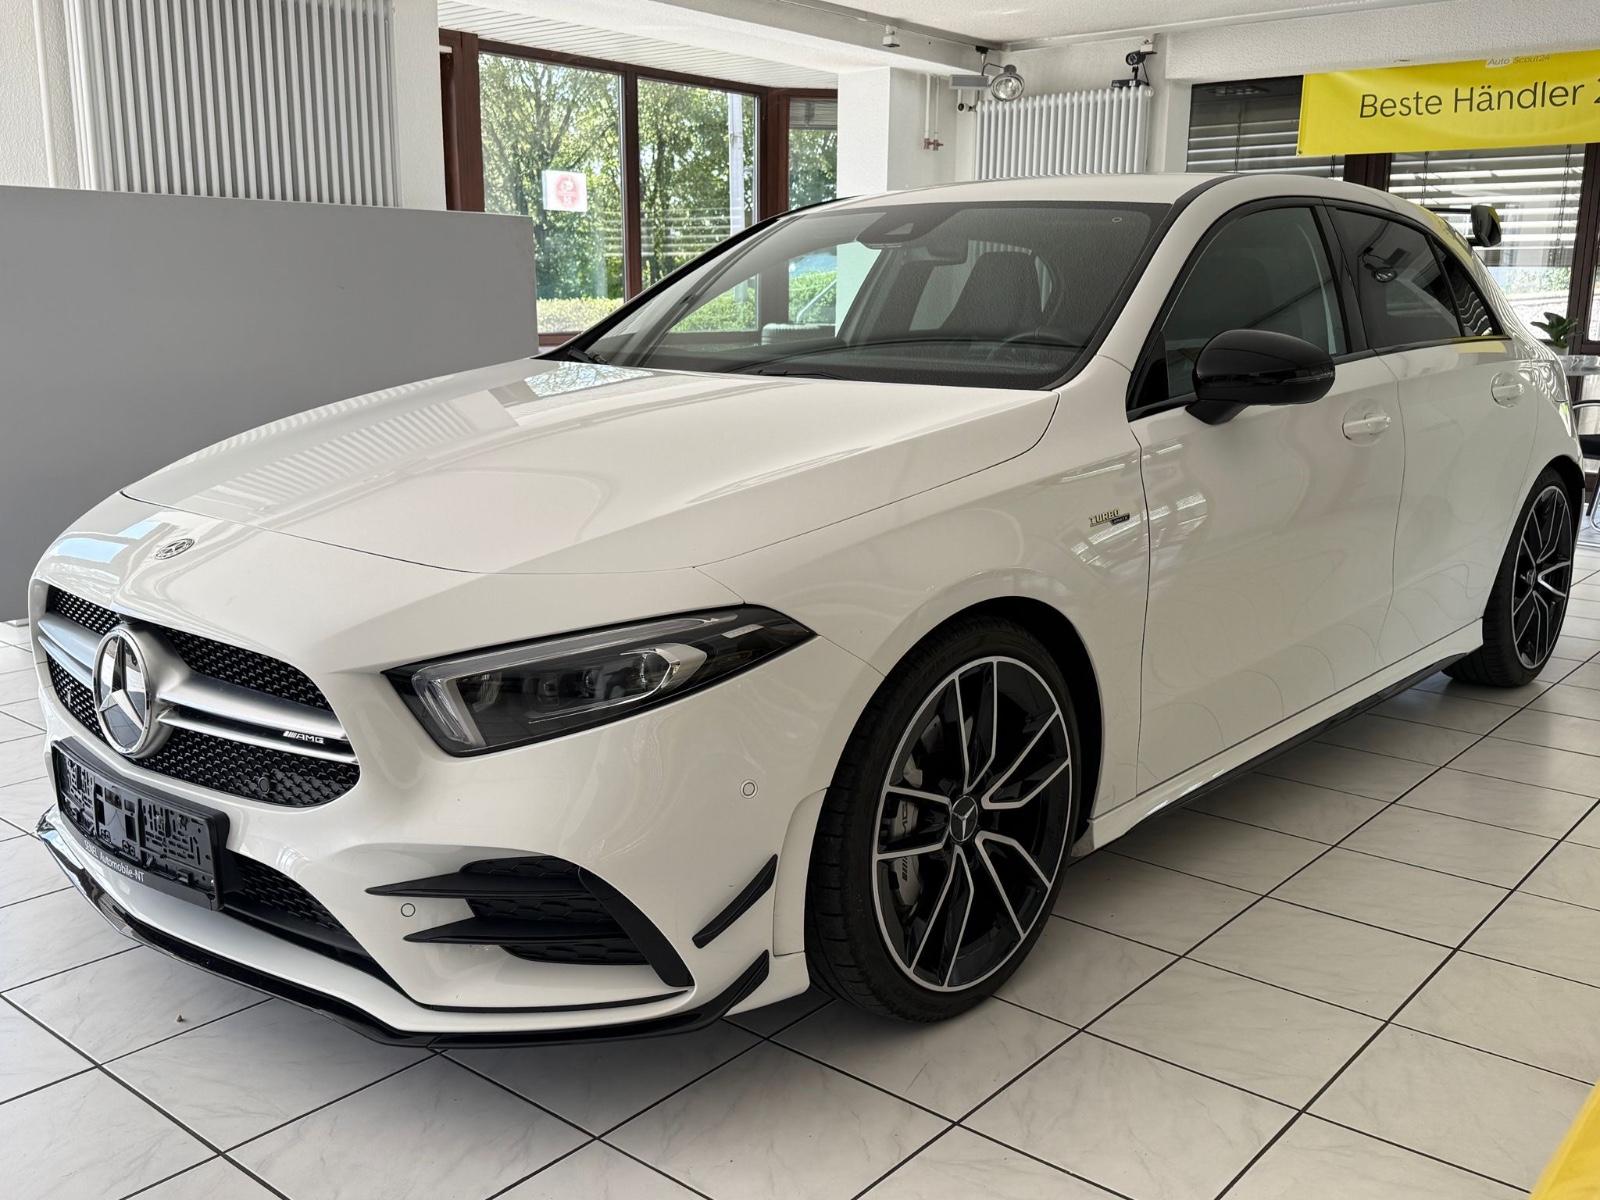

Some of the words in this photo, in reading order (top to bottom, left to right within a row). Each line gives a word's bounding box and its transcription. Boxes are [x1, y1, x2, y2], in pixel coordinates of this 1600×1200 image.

[1359, 90, 1443, 119] Beste
[1453, 80, 1585, 113] Händler
[1088, 509, 1120, 526] TURBO
[295, 733, 325, 745] AMG
